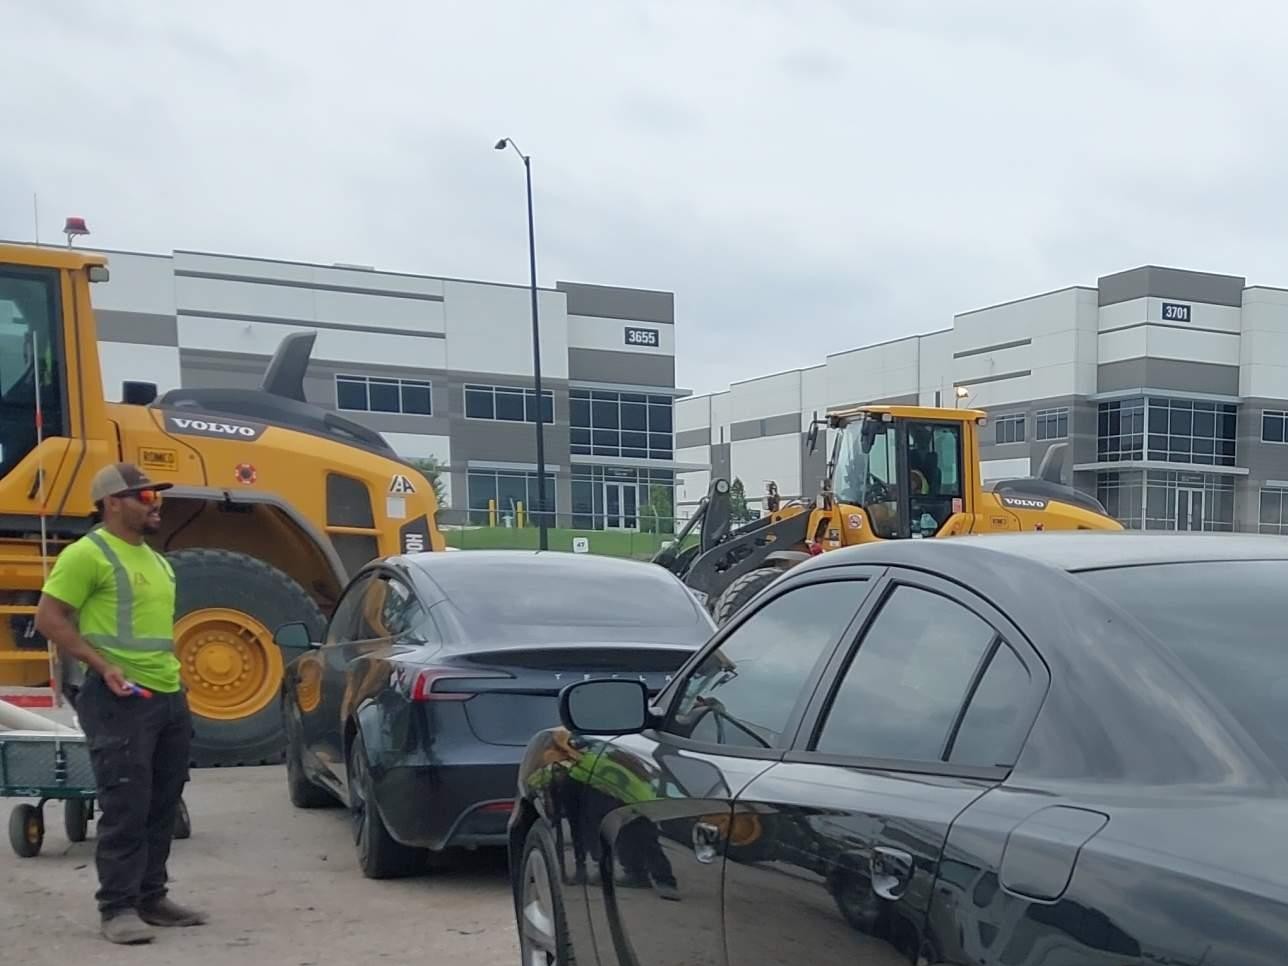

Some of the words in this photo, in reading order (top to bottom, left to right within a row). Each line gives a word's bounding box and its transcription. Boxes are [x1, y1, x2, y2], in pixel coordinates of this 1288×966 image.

[1166, 305, 1188, 320] 3701
[628, 330, 657, 344] 3655
[170, 417, 256, 437] VOLVO
[1005, 498, 1045, 508] VOLVO
